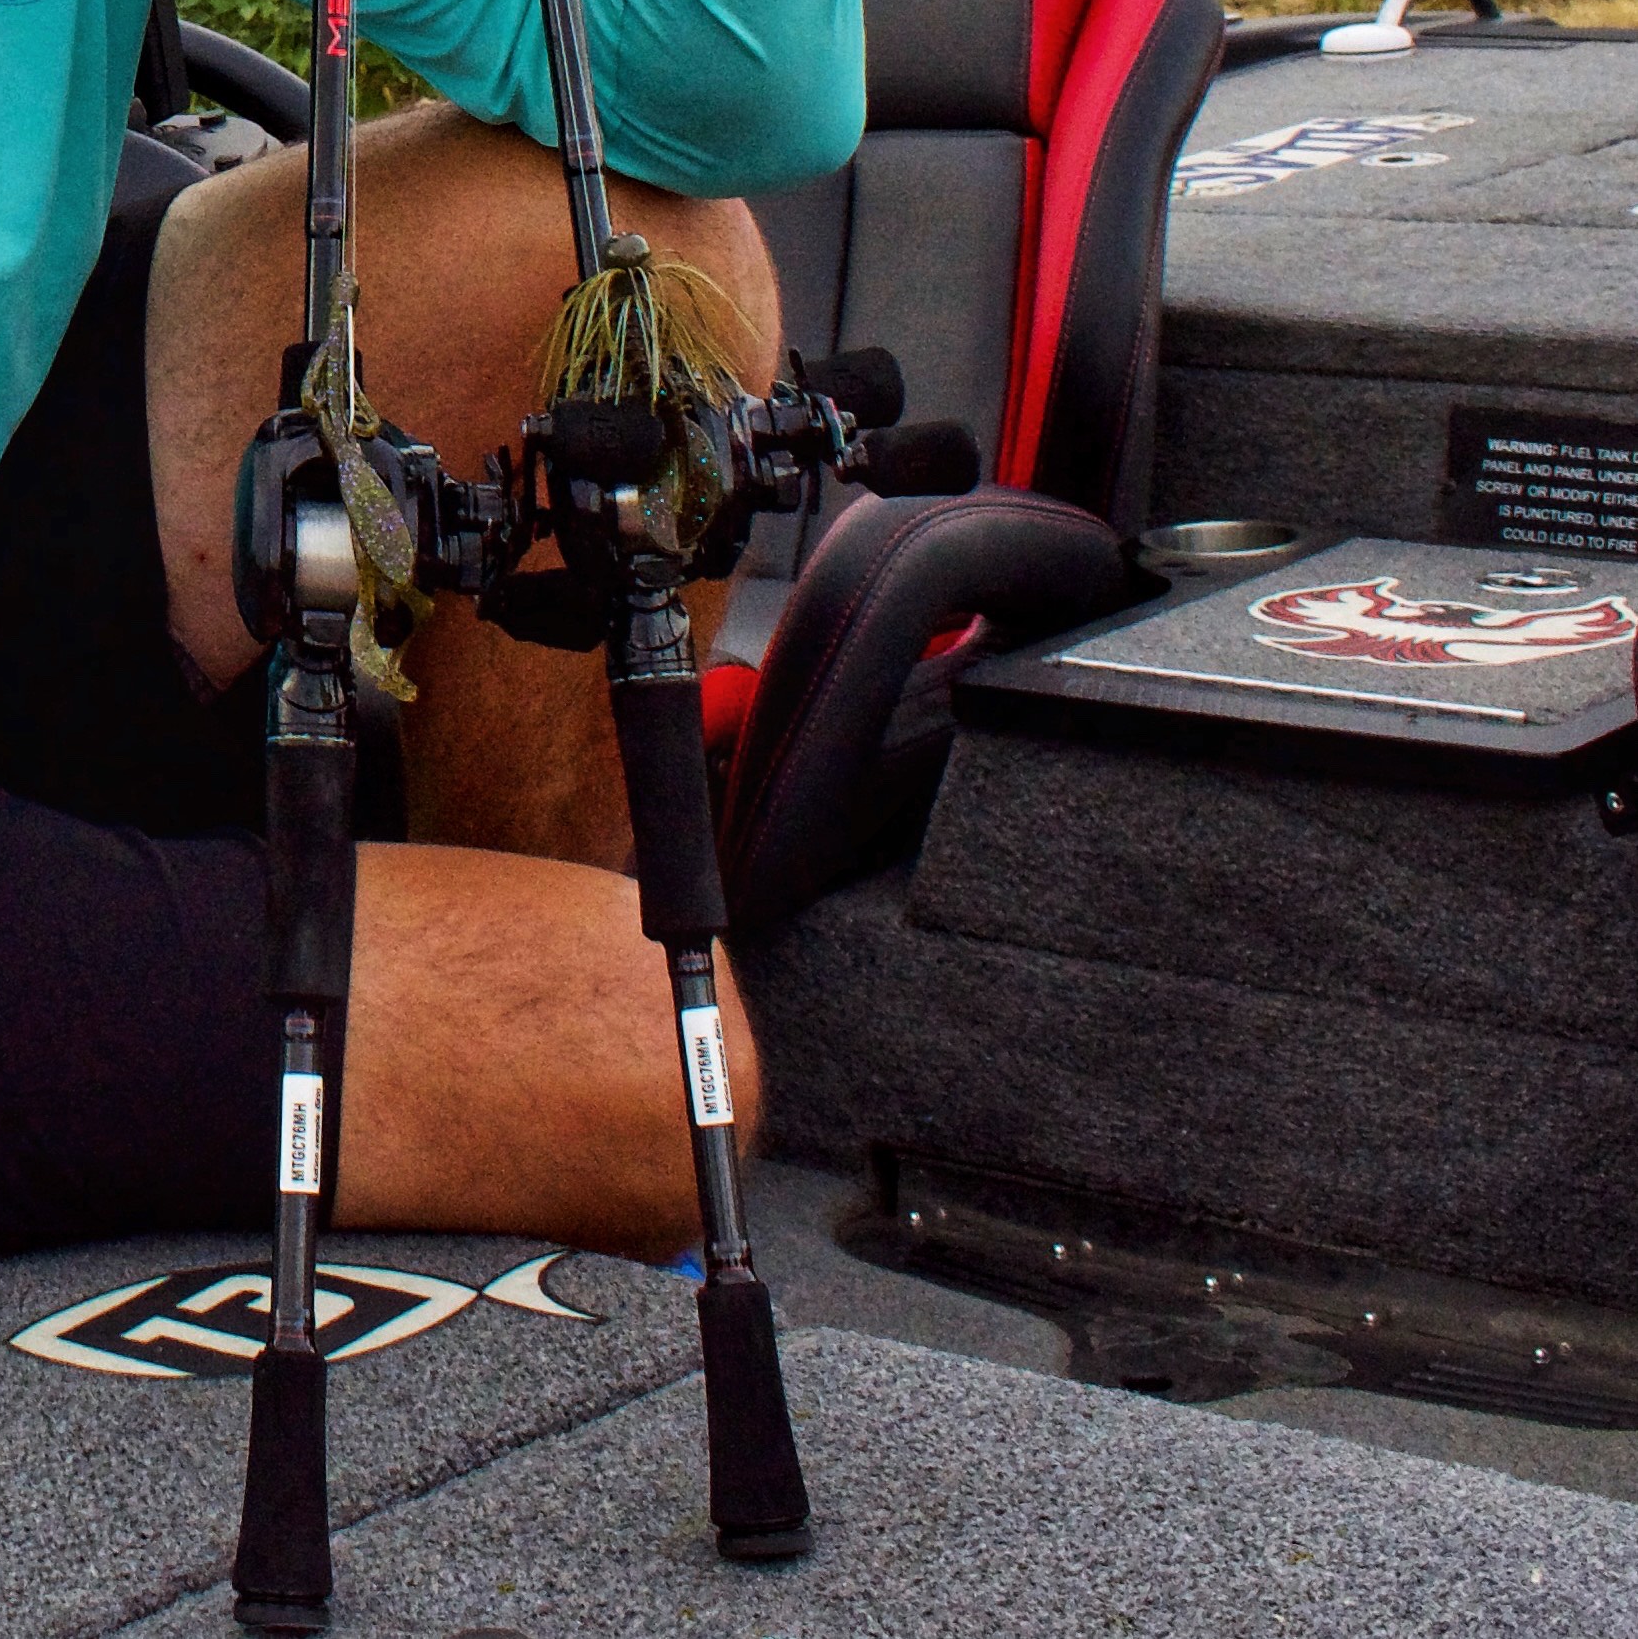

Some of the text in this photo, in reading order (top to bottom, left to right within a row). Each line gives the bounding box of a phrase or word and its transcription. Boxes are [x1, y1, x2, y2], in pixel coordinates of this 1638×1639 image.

[1487, 438, 1559, 456] WARNING:
[1560, 444, 1594, 460] FUEL
[1596, 448, 1630, 462] TANK
[1482, 459, 1521, 474] PANEL
[1524, 463, 1552, 477] AND
[1554, 465, 1595, 481] PANEL
[1475, 480, 1523, 496] SCREW
[1527, 485, 1548, 498] OR
[1550, 487, 1601, 502] MODIFY
[1498, 505, 1511, 517] IS
[1502, 527, 1637, 553] COULD LEAD TO FIRE
